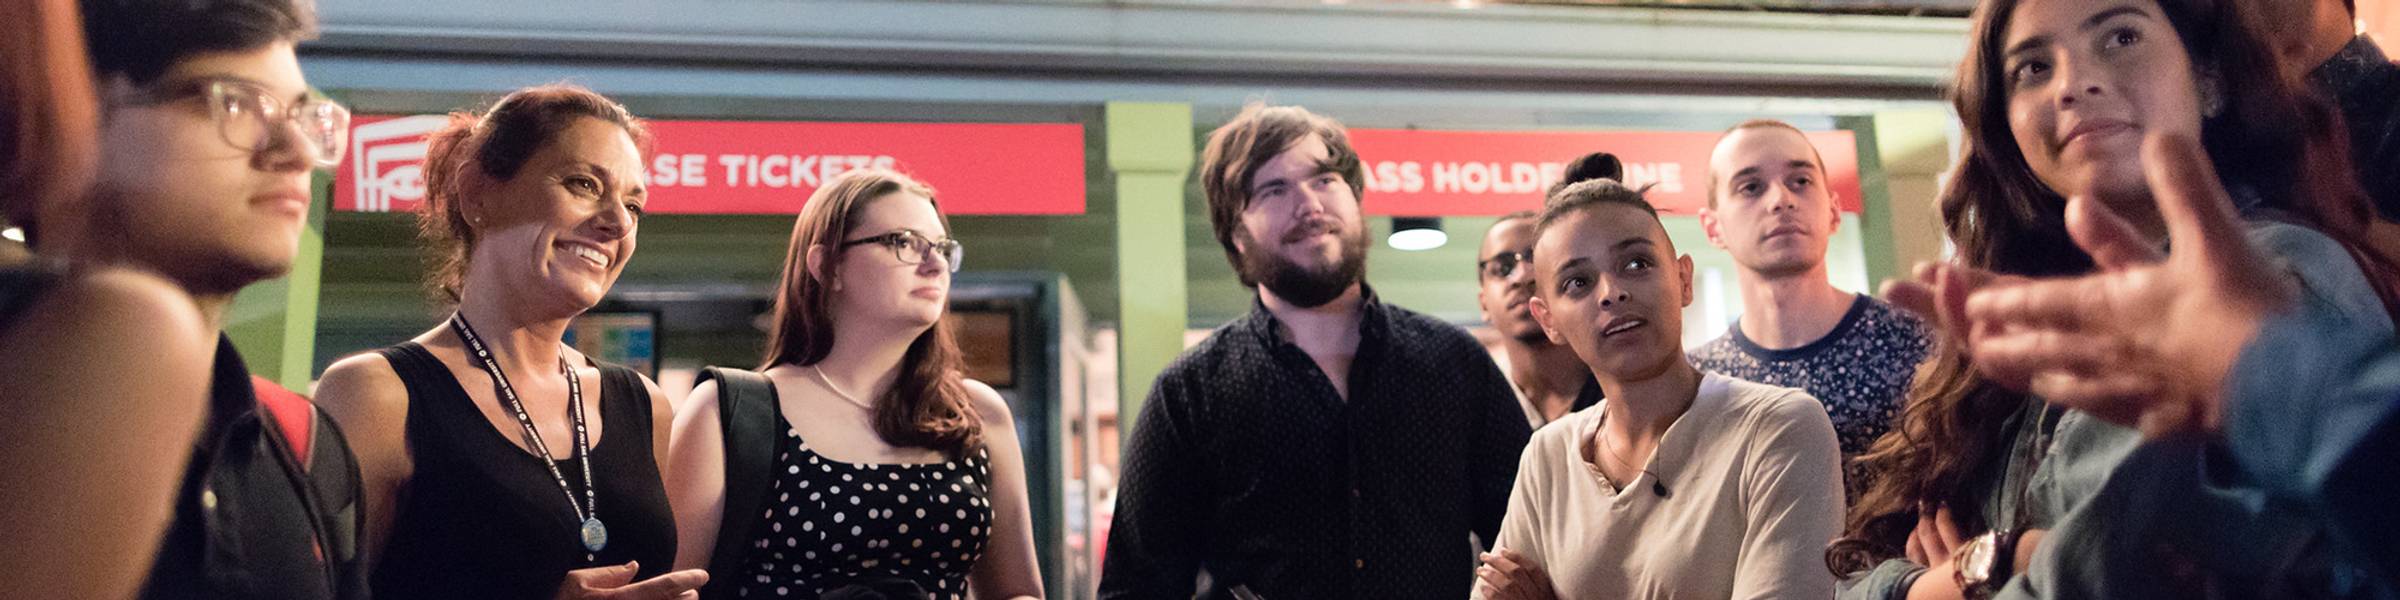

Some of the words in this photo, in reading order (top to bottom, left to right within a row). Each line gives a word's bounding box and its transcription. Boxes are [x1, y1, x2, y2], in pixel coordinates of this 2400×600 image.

[1432, 161, 1566, 194] HOLDE
[485, 359, 508, 389] UNIVERSITY
[504, 387, 515, 400] SAIL
[511, 399, 523, 413] FULL
